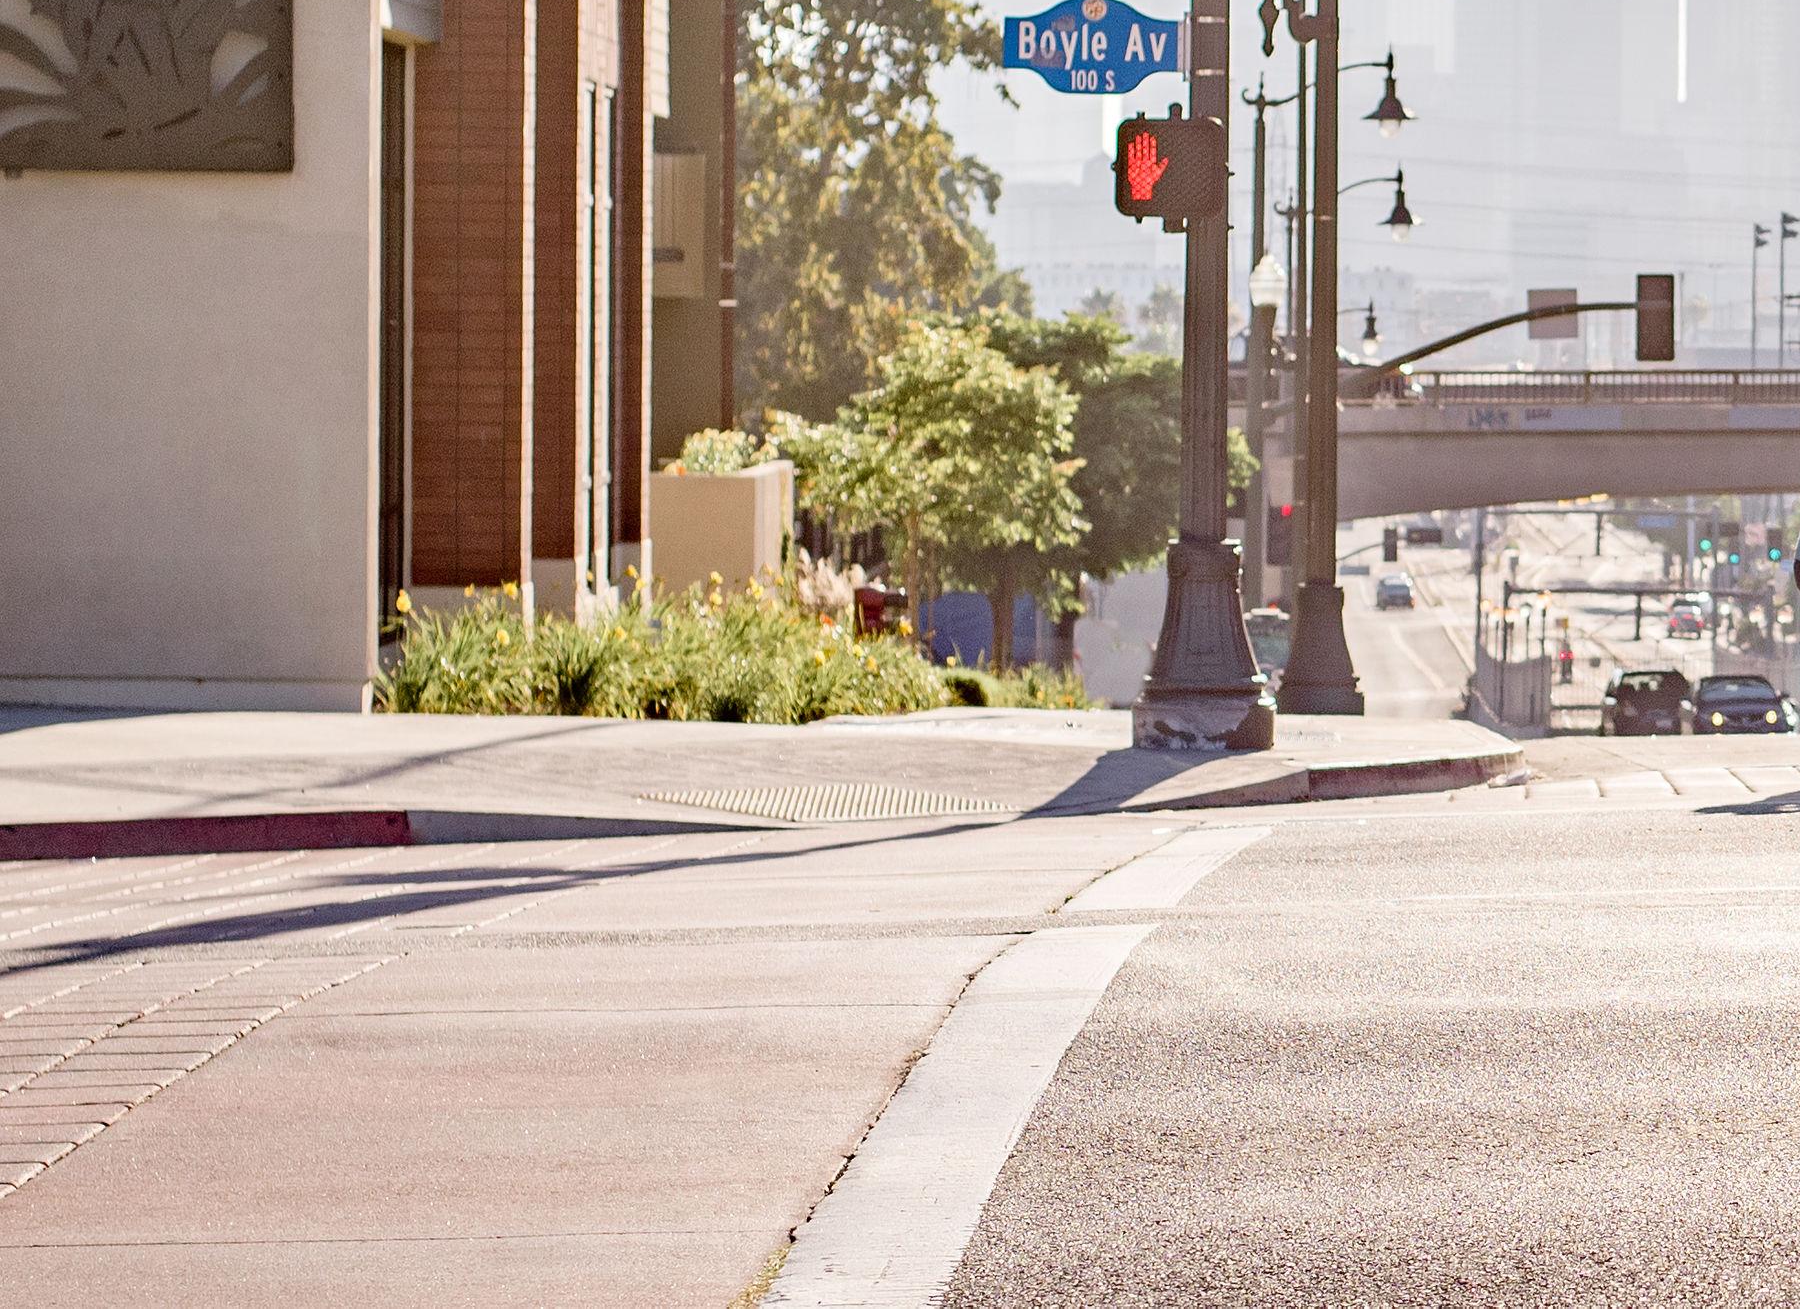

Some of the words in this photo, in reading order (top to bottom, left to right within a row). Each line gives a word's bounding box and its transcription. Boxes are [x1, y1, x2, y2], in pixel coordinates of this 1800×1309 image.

[1018, 21, 1107, 69] Boyle
[1125, 23, 1166, 62] Av
[1071, 70, 1098, 90] 100
[1106, 70, 1116, 91] S
